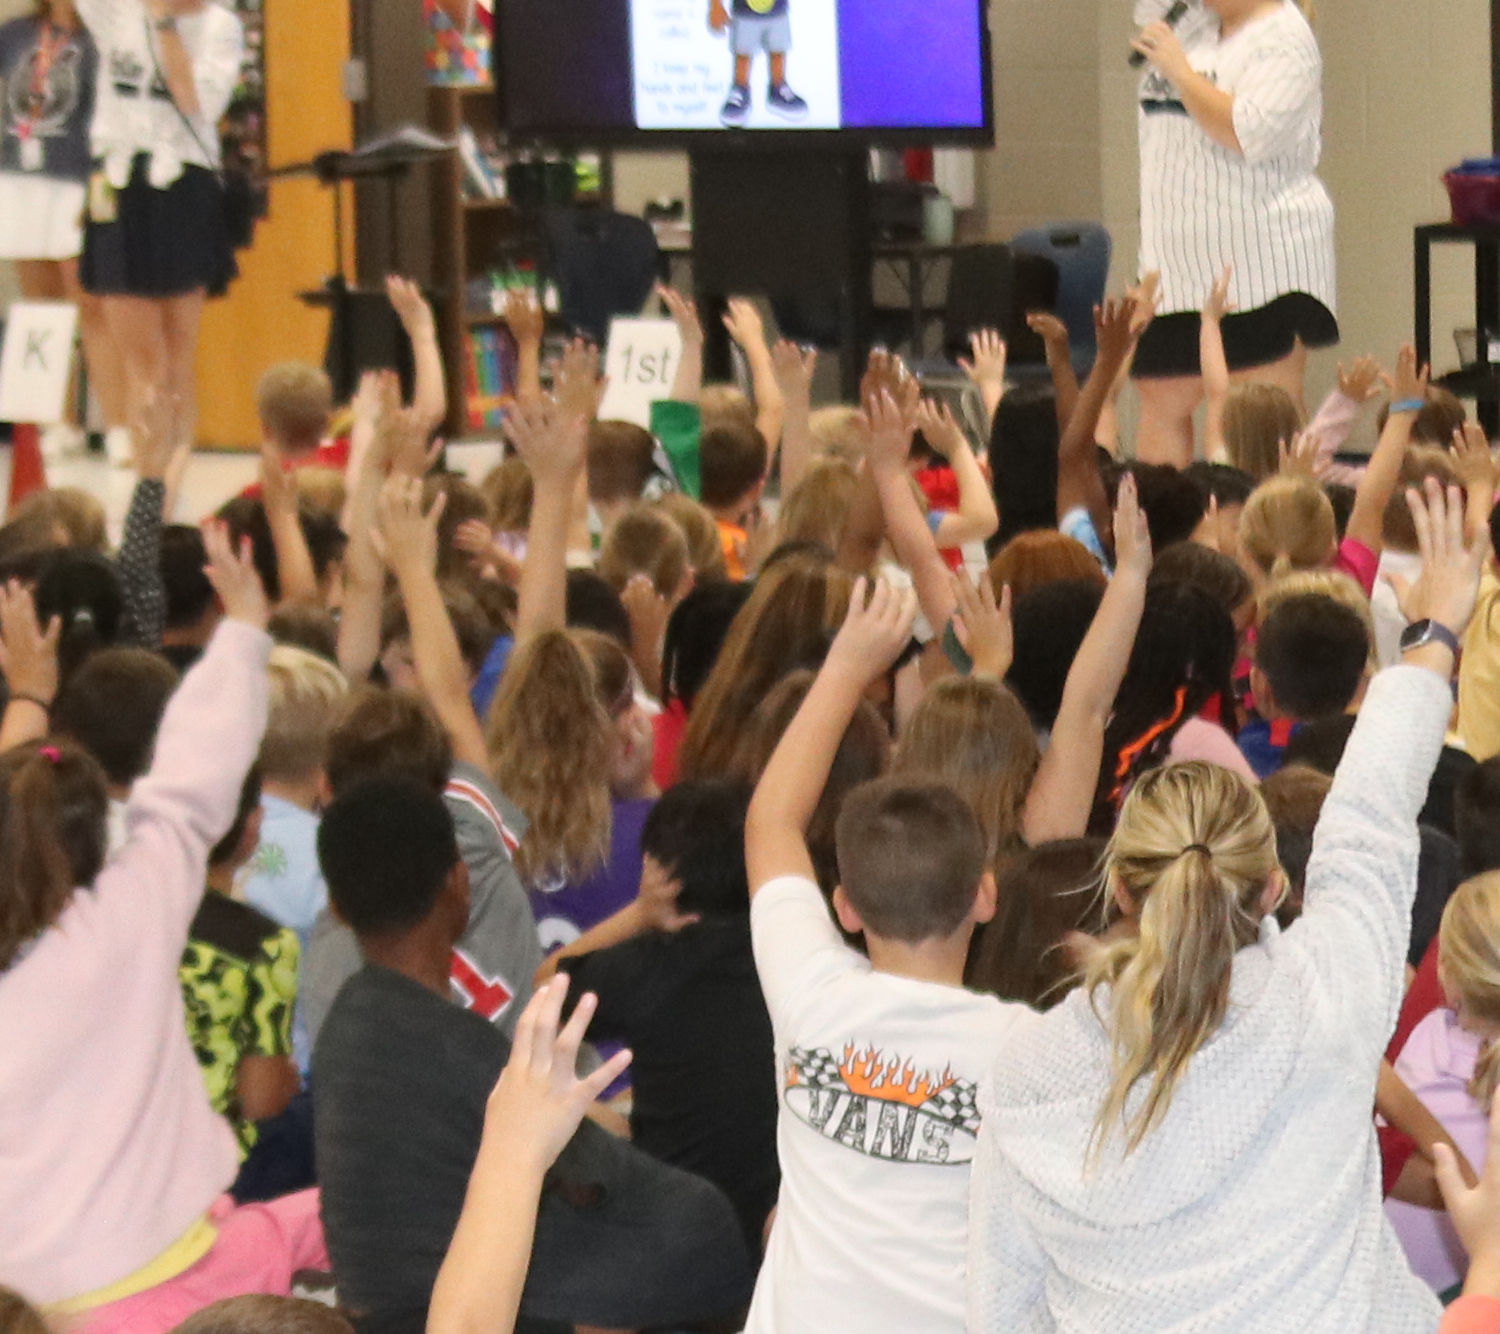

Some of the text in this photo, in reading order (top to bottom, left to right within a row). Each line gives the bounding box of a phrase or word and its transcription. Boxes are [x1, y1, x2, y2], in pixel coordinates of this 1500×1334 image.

[21, 327, 53, 372] K
[621, 345, 670, 384] 1st
[808, 1088, 954, 1163] VANS
